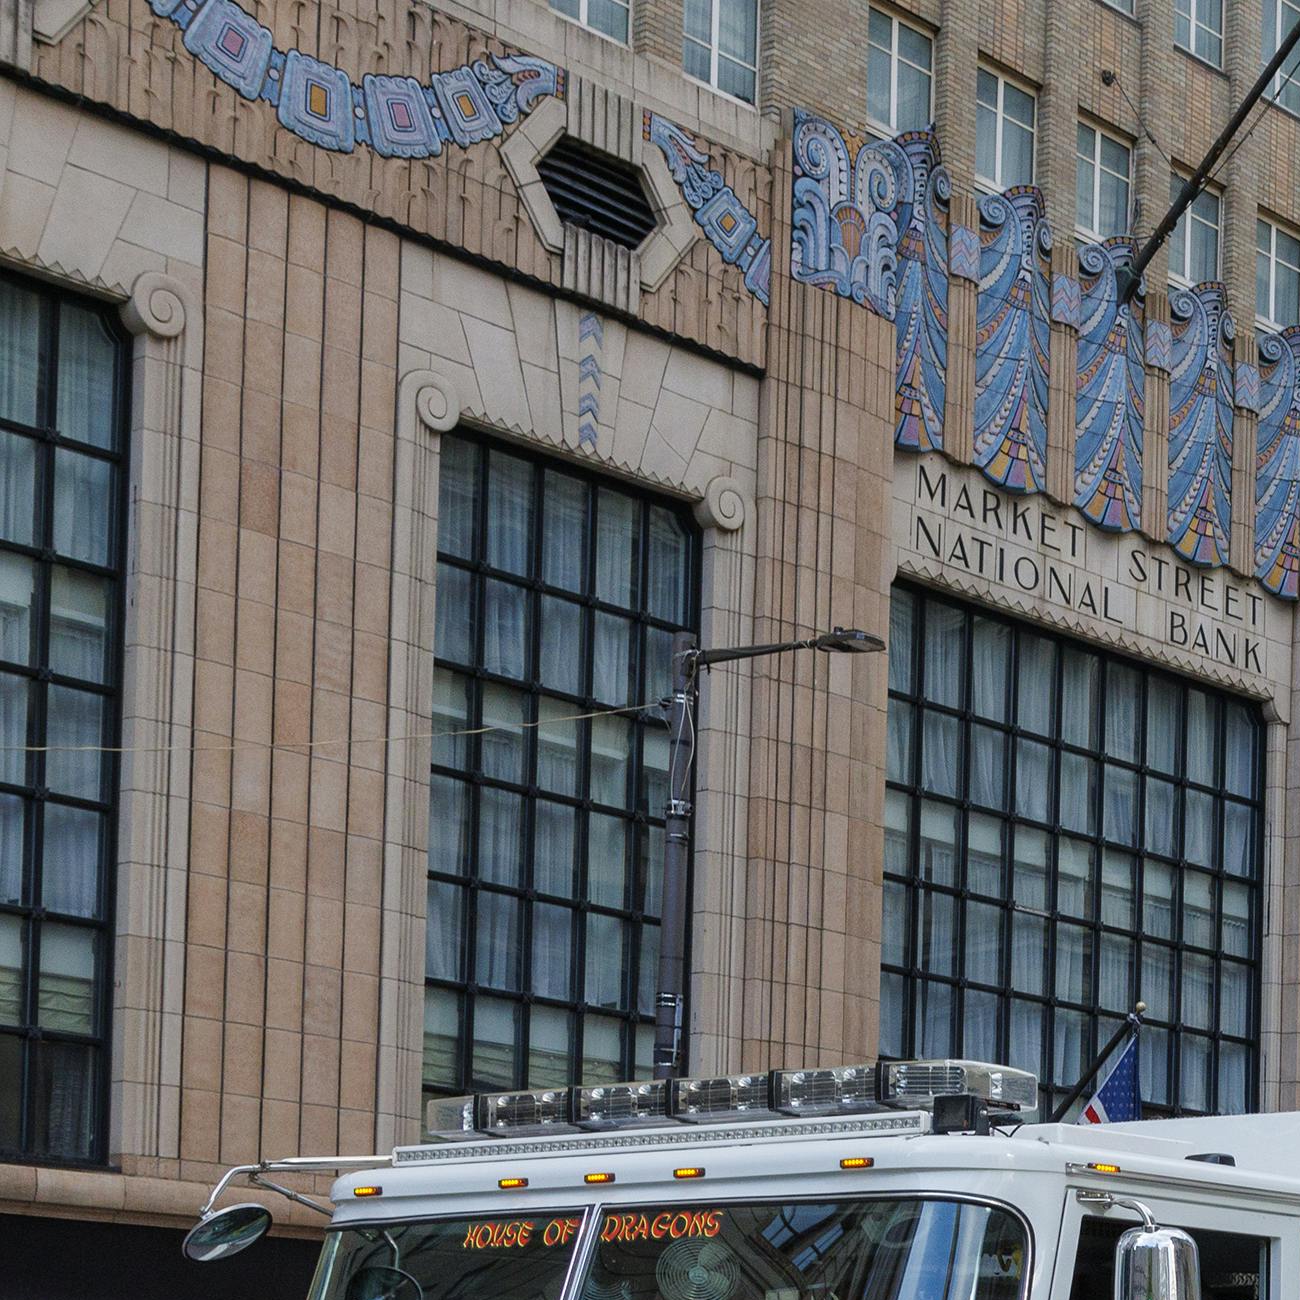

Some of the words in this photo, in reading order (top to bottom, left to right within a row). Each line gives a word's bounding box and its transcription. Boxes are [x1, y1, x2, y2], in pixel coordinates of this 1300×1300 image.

[916, 516, 1123, 624] NATIONAL
[1170, 611, 1262, 673] BANK
[918, 464, 1083, 557] MARKET
[1129, 550, 1263, 626] STREET
[463, 1220, 534, 1248] HOUSE
[544, 1218, 581, 1246] OF
[601, 1210, 724, 1242] DRAGONS
